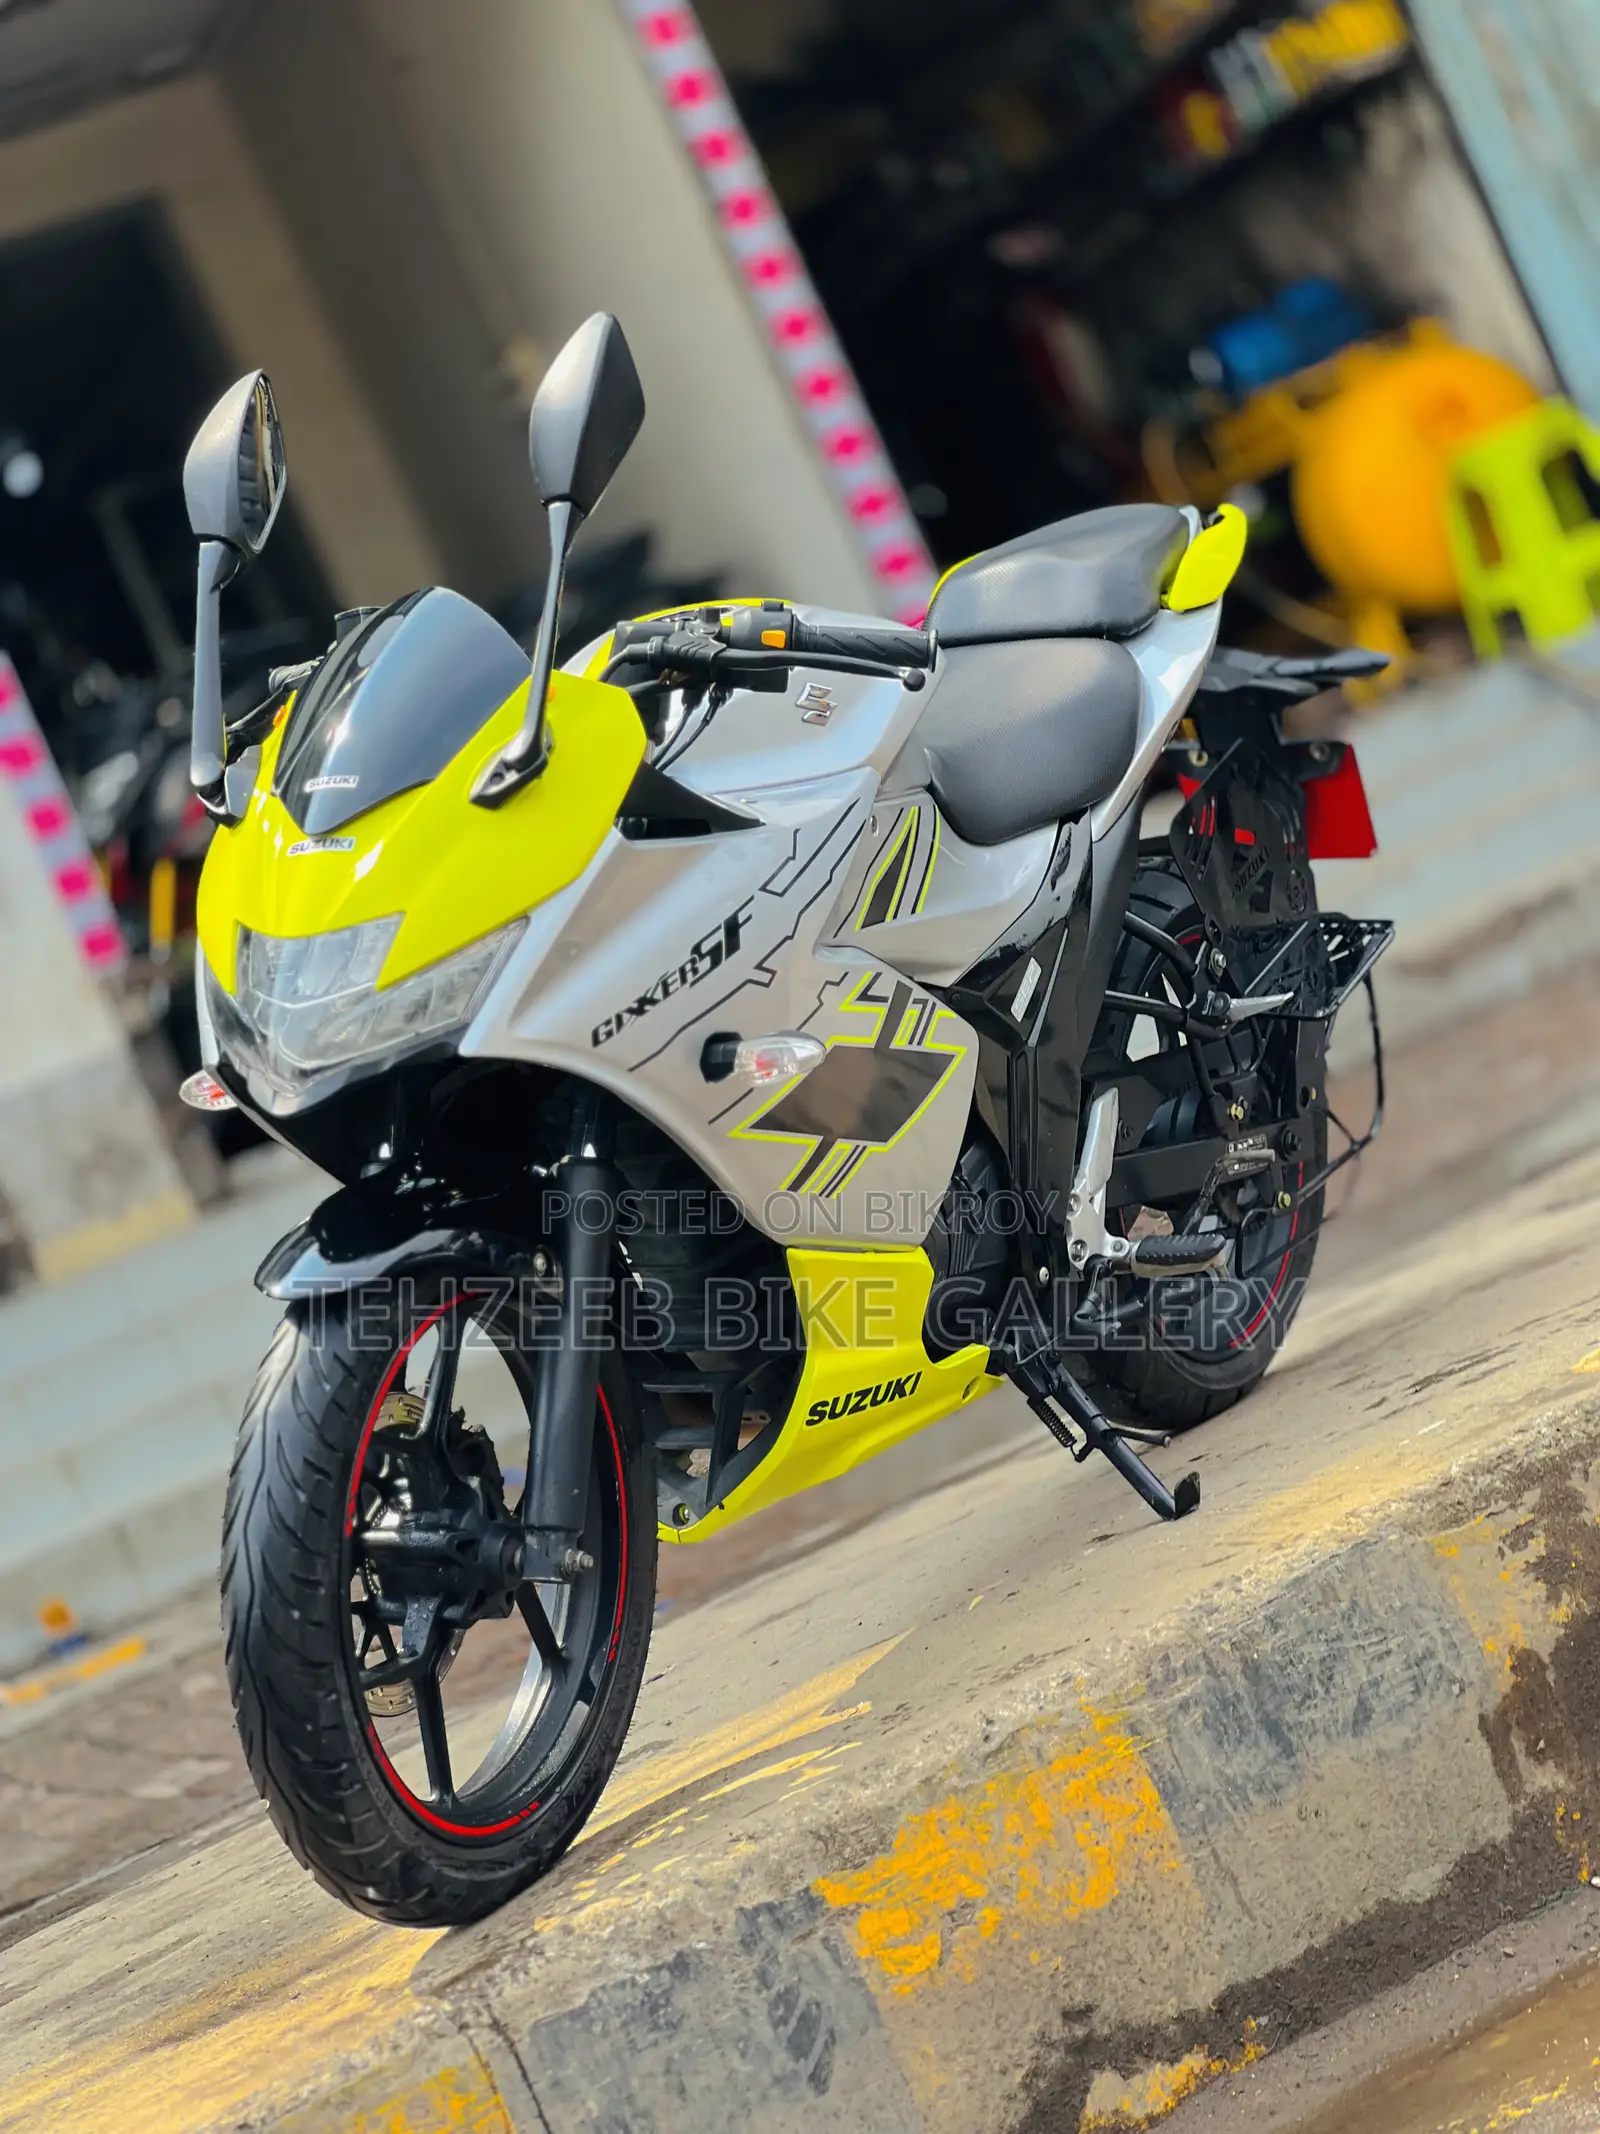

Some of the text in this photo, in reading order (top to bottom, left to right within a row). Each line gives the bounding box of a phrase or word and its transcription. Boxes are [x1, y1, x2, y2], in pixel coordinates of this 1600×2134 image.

[308, 775, 359, 789] SUZUKI
[289, 838, 355, 855] SUZUKI
[805, 1370, 923, 1427] SUZUKI
